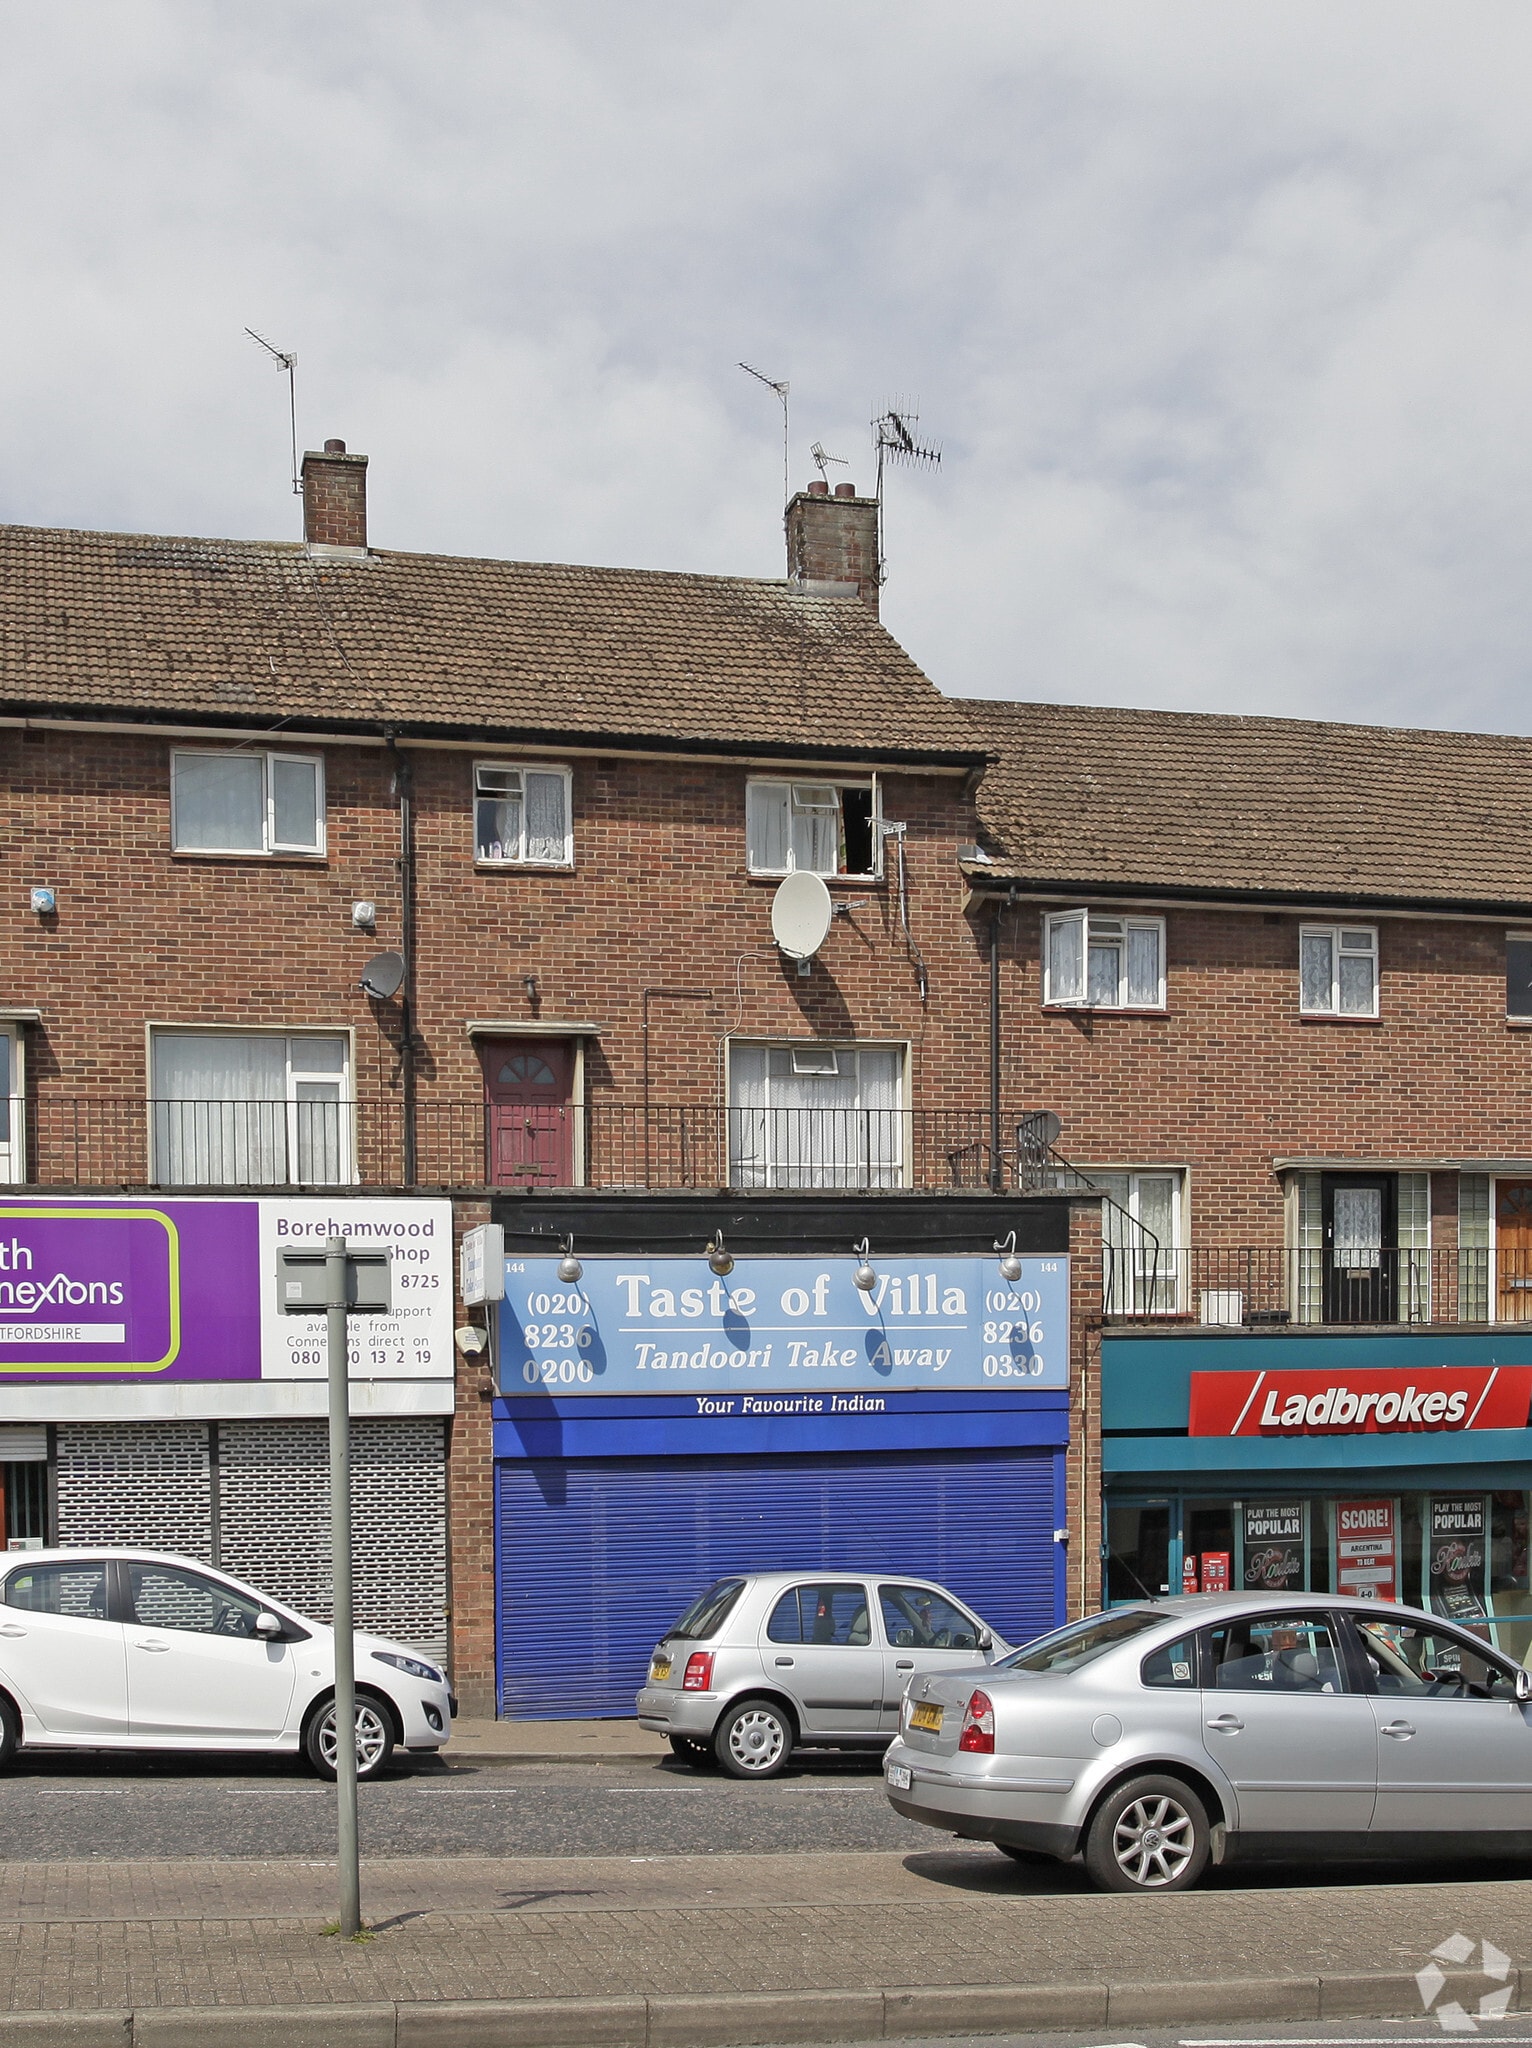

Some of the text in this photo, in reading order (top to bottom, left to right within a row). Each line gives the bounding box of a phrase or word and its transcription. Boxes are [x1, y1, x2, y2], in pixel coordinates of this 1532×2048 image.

[276, 1218, 434, 1237] Borehamwood
[506, 1263, 525, 1273] 144
[1040, 1262, 1057, 1272] 144
[401, 1274, 439, 1288] 8725
[616, 1273, 968, 1317] Taste of Villa
[985, 1290, 1041, 1313] (020)
[527, 1292, 590, 1316] (020)
[382, 1307, 432, 1319] upport
[0, 1327, 82, 1340] TFORDSHIRE
[306, 1320, 400, 1331] avale from
[983, 1321, 1044, 1344] 8236
[286, 1335, 429, 1347] Connens direct on
[524, 1324, 592, 1349] 8236
[291, 1351, 321, 1364] 080
[370, 1350, 386, 1364] 13
[396, 1350, 405, 1364] 2
[415, 1350, 431, 1364] 19
[634, 1341, 952, 1372] Tandoori Take Away
[522, 1360, 594, 1384] 0200
[982, 1354, 1044, 1377] 0330
[696, 1395, 885, 1414] Your Favourite Indian
[1259, 1386, 1469, 1427] Ladbrokes
[1247, 1507, 1300, 1519] PLAY THE MOST
[1434, 1502, 1482, 1513] PLAY THE MOST
[1247, 1518, 1300, 1536] POPULAR
[1341, 1509, 1389, 1529] SCORE!
[1434, 1513, 1482, 1529] POPULAR
[1350, 1543, 1383, 1552] ARGENTINA
[1360, 1590, 1373, 1598] 4-0
